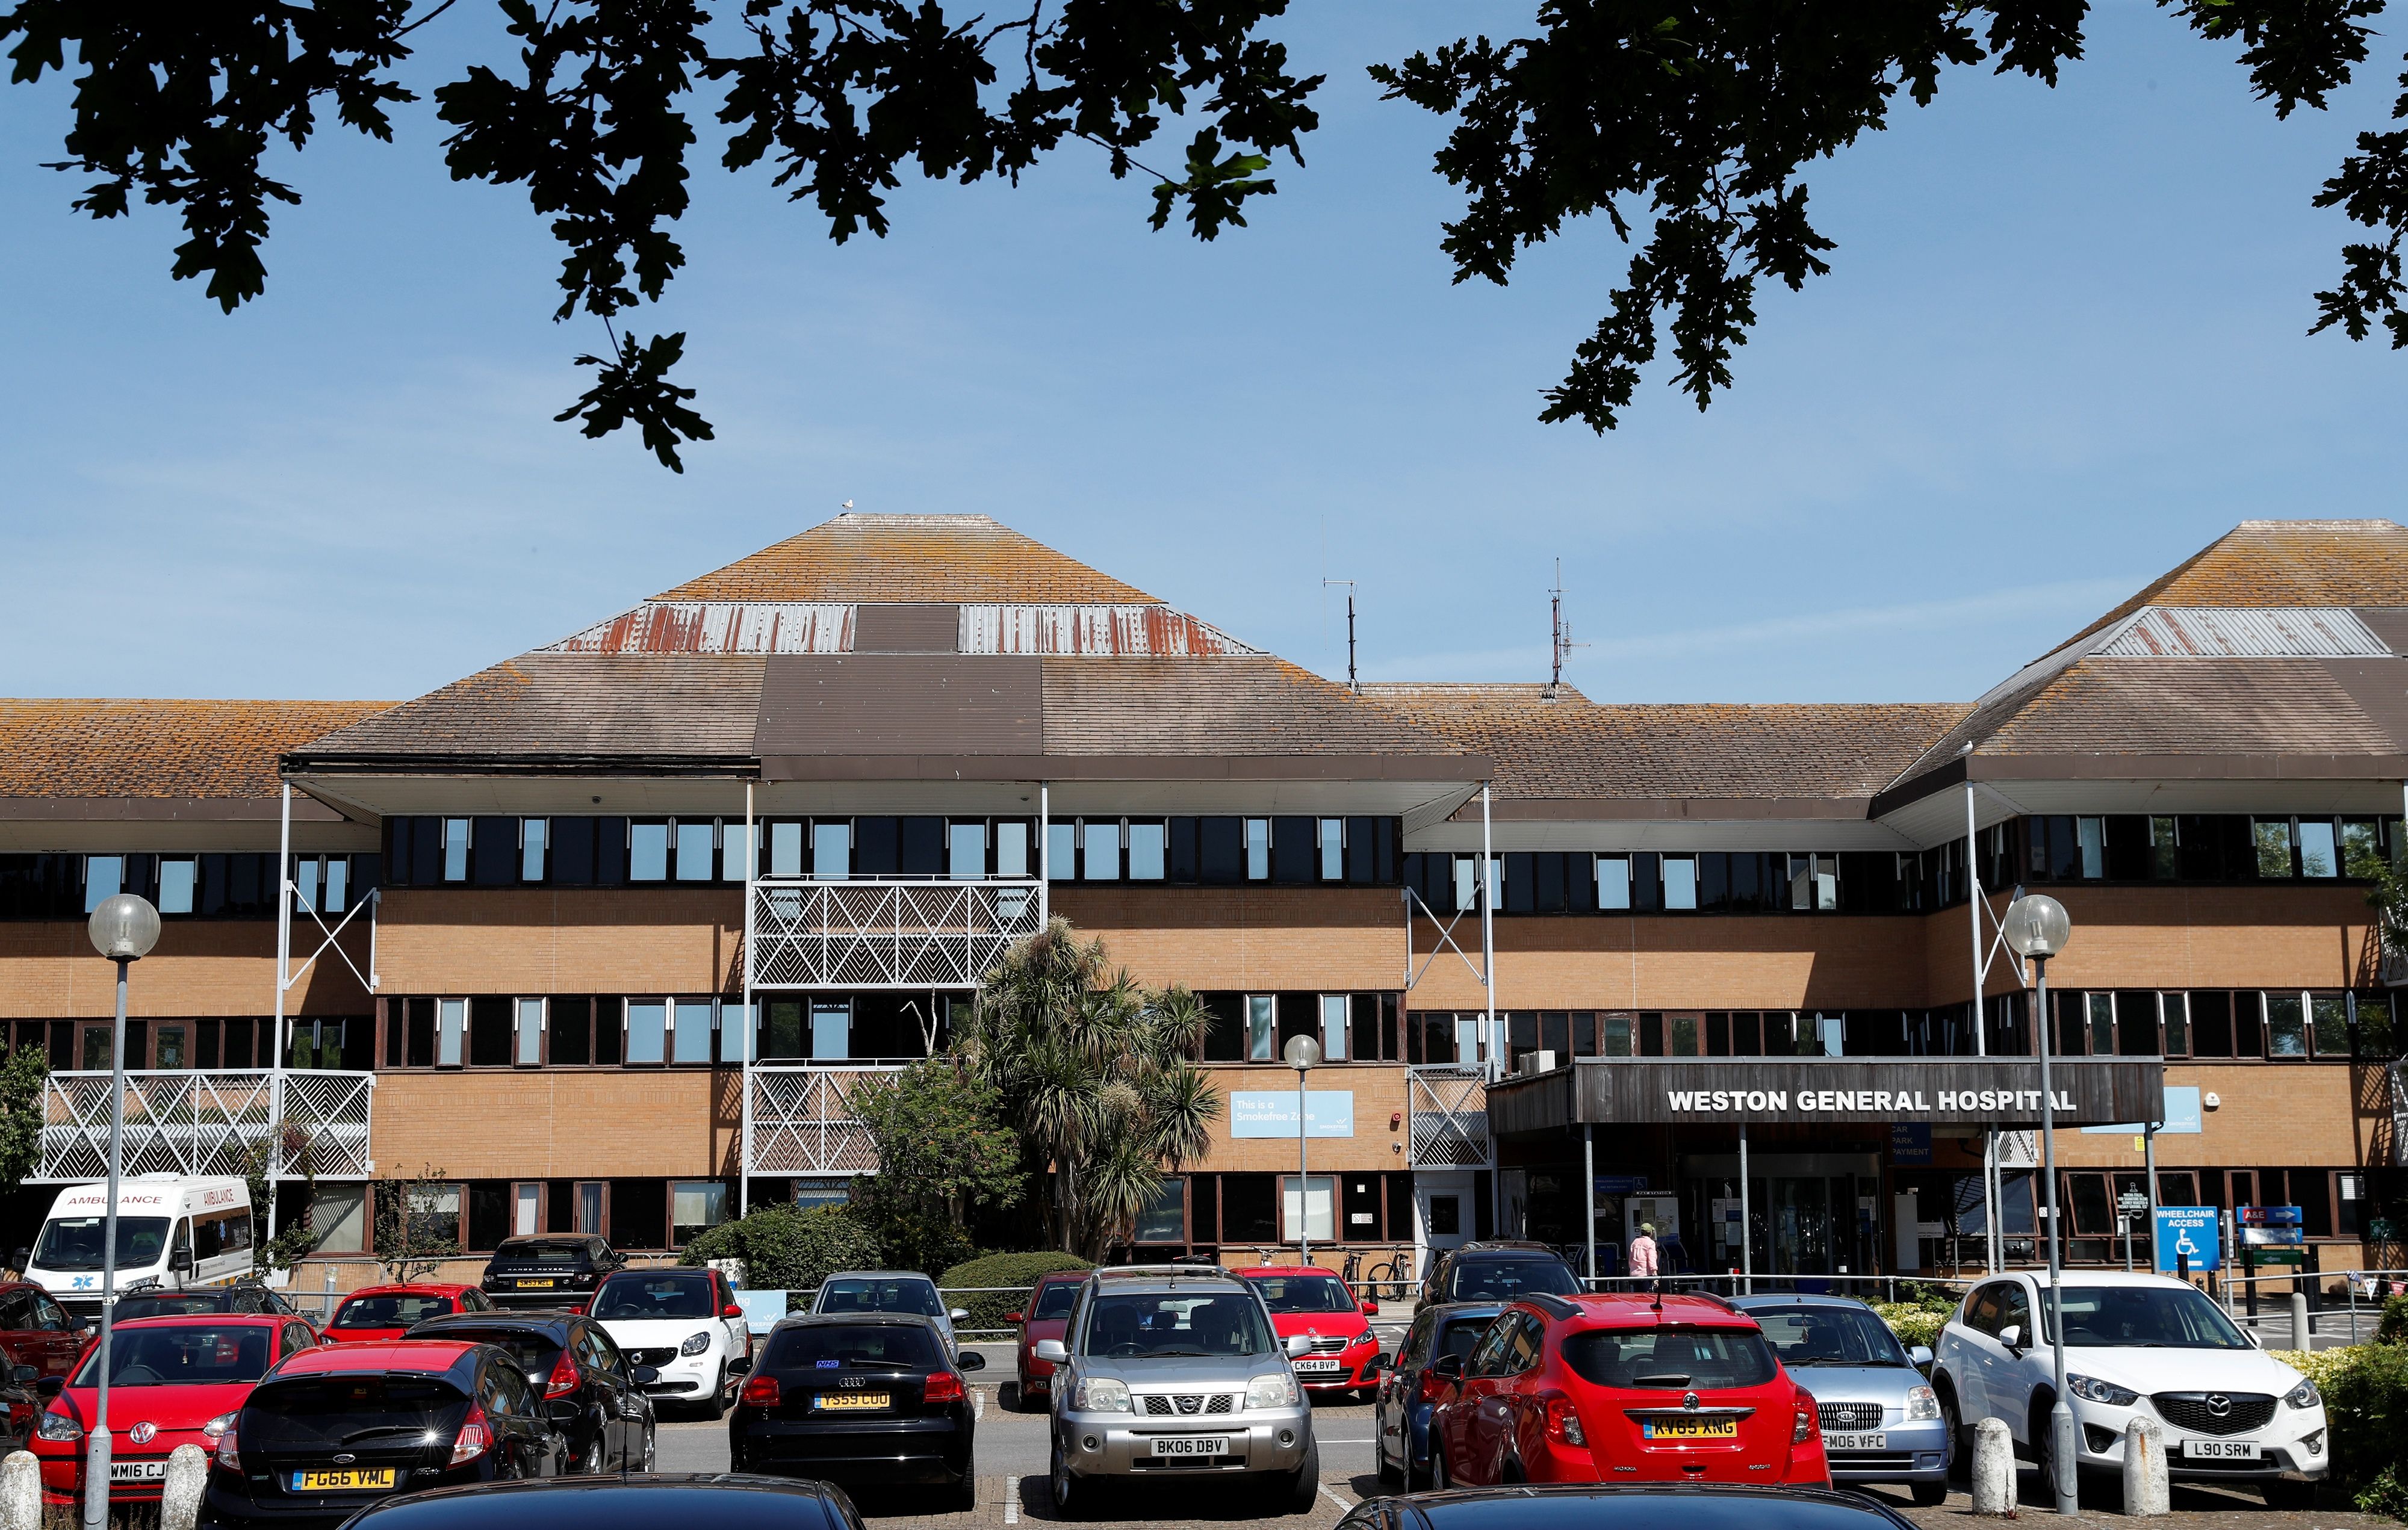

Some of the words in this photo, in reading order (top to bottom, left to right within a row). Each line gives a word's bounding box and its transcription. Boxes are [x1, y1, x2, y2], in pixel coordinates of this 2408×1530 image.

[1237, 1100, 1255, 1109] This
[1258, 1100, 1265, 1109] is
[1668, 1090, 1787, 1111] WESTON
[1797, 1090, 1931, 1111] GENERAL
[1237, 1112, 1288, 1121] Smokefree
[67, 1196, 163, 1205] AMBUANCE
[203, 1188, 234, 1206] AMBULANCE
[2168, 1219, 2205, 1227] ACCESS
[1295, 1361, 1317, 1370] CK64
[1319, 1361, 1336, 1369] BVP
[824, 1393, 858, 1405] YS59
[862, 1392, 888, 1405] CUO
[1655, 1418, 1697, 1435] KV65
[1701, 1418, 1733, 1434] XNG
[1158, 1440, 1193, 1453] BK06
[1196, 1440, 1222, 1452] DBV
[1822, 1436, 1855, 1448] FM06
[1858, 1436, 1884, 1448] VFC
[2195, 1443, 2221, 1456] L90
[2224, 1443, 2250, 1457] SRM
[111, 1464, 142, 1478] WM16
[146, 1463, 169, 1477] CJ
[304, 1470, 352, 1487] FG66
[357, 1469, 390, 1485] VML
